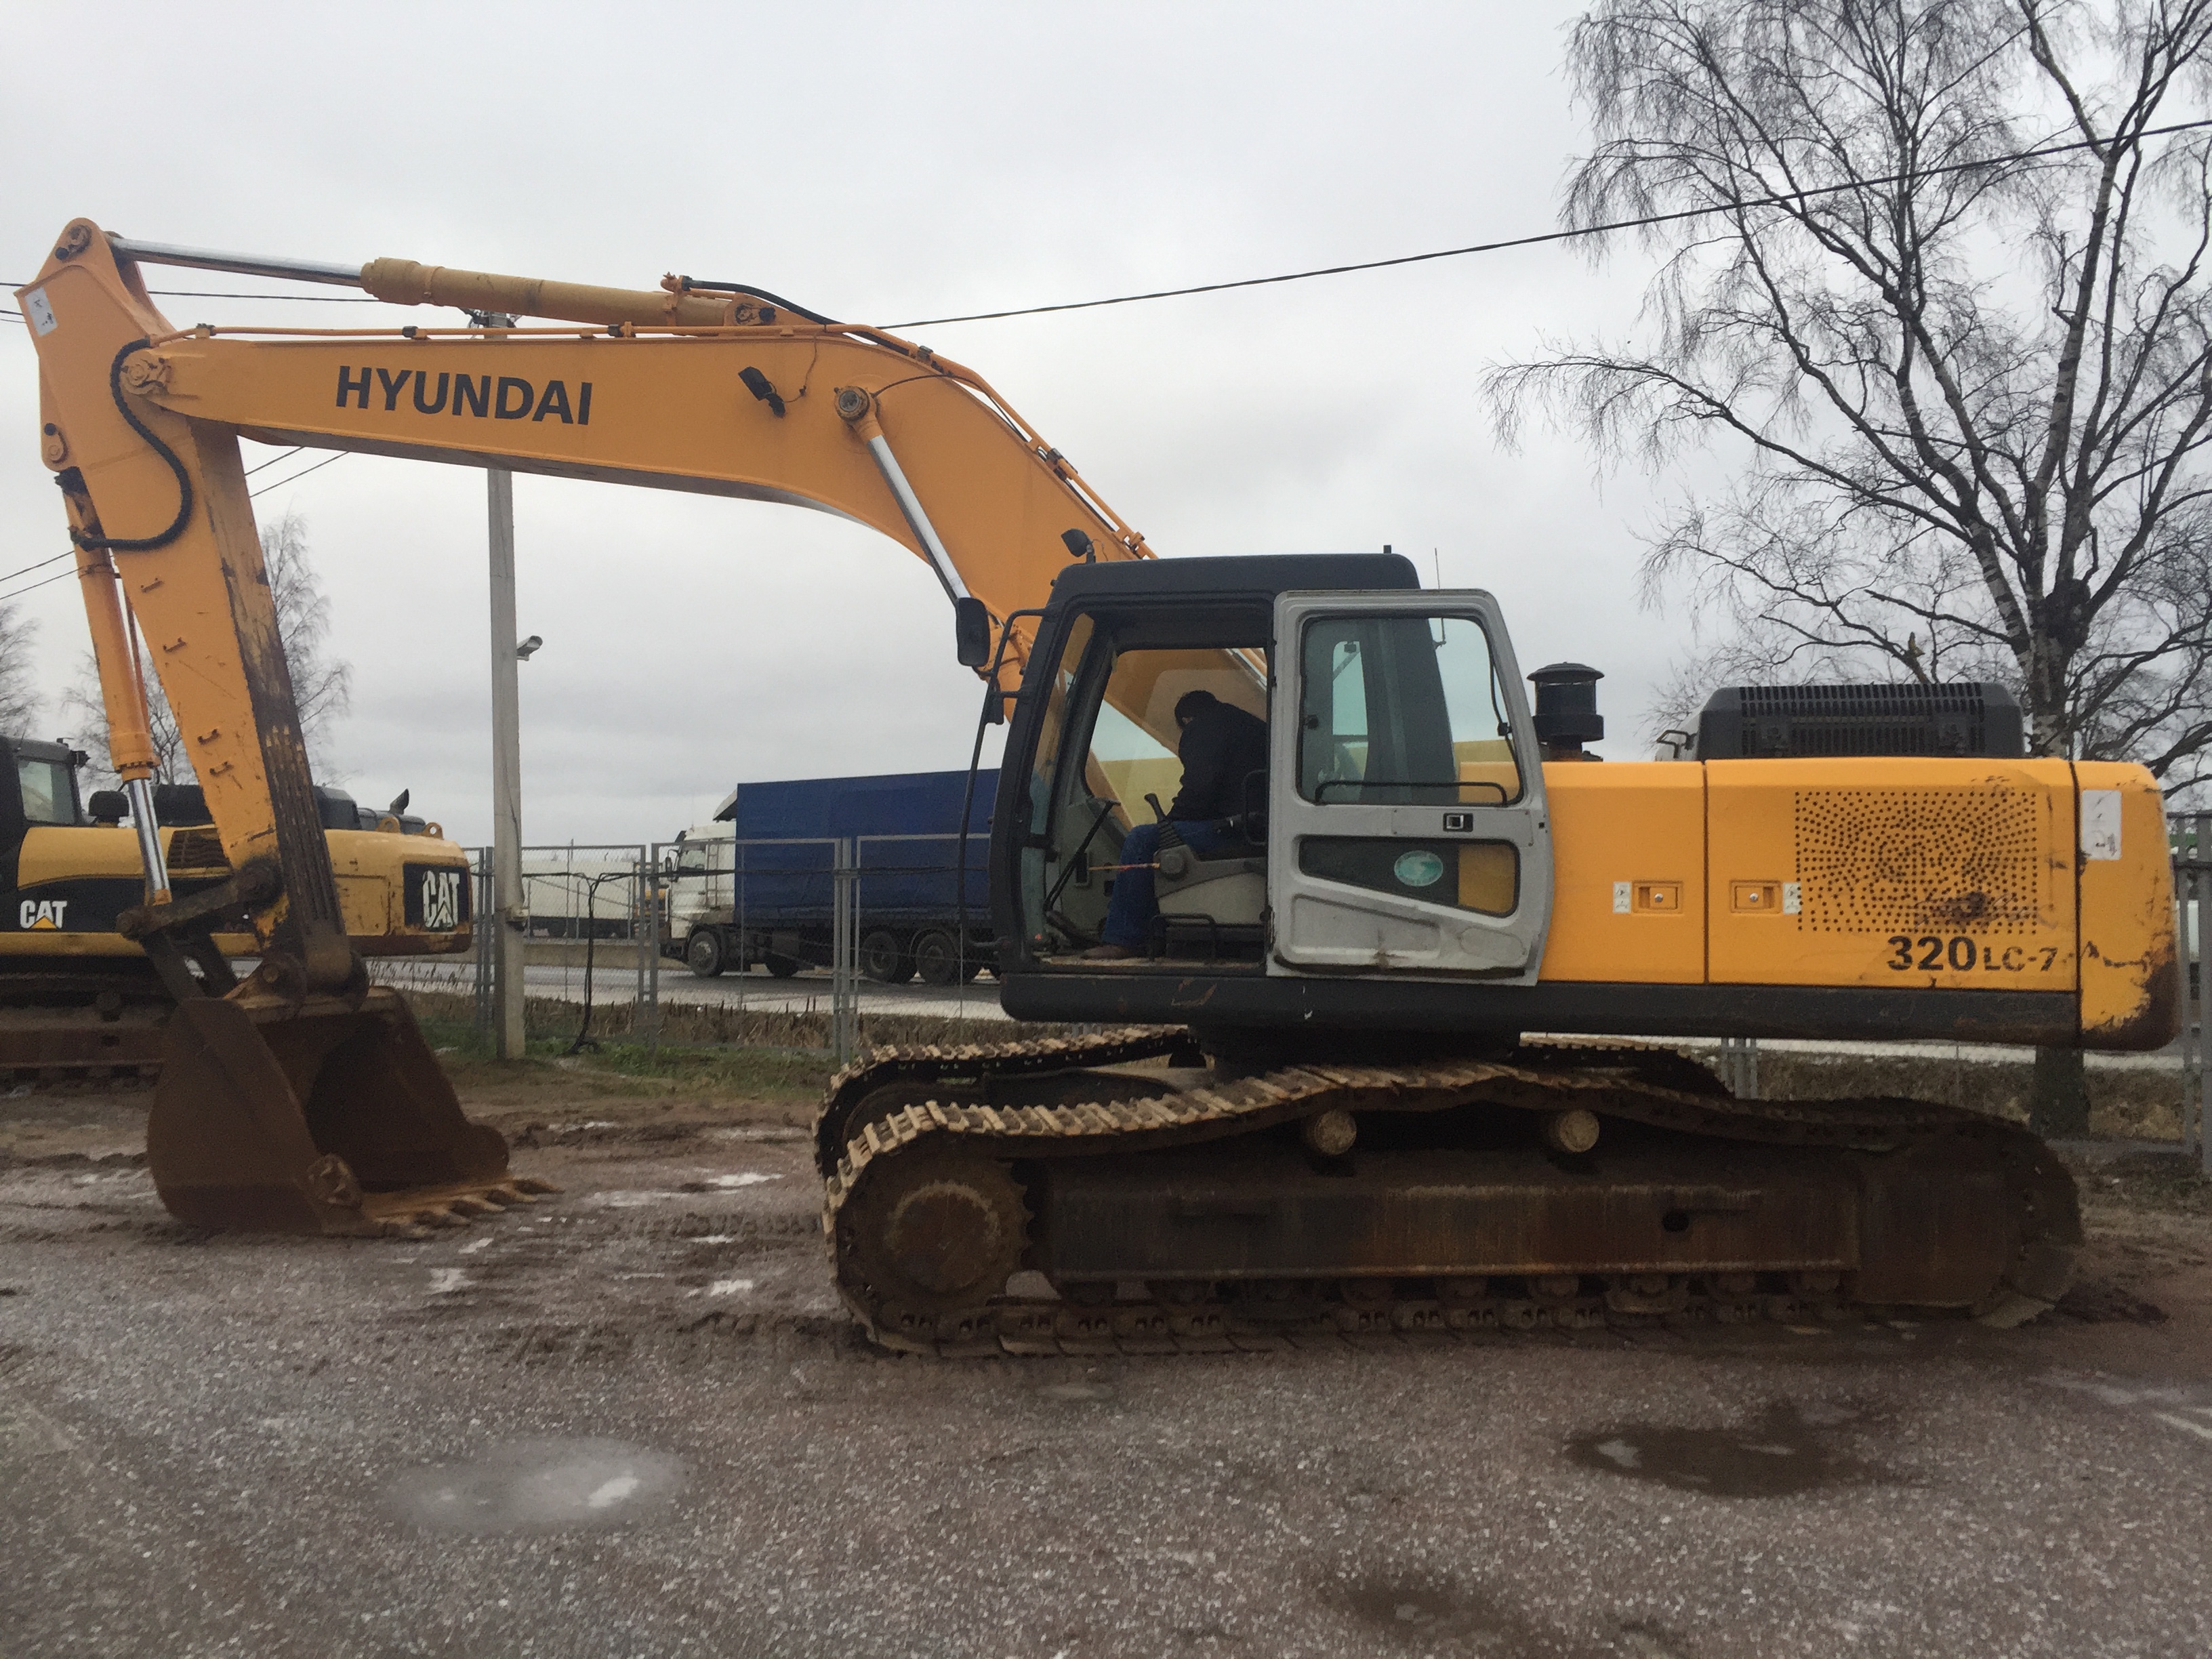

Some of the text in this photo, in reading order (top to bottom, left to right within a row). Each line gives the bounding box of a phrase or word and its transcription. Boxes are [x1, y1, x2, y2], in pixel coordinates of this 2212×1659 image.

[336, 365, 592, 426] HYUNDAI
[20, 899, 68, 929] CAT
[422, 870, 460, 928] CAT
